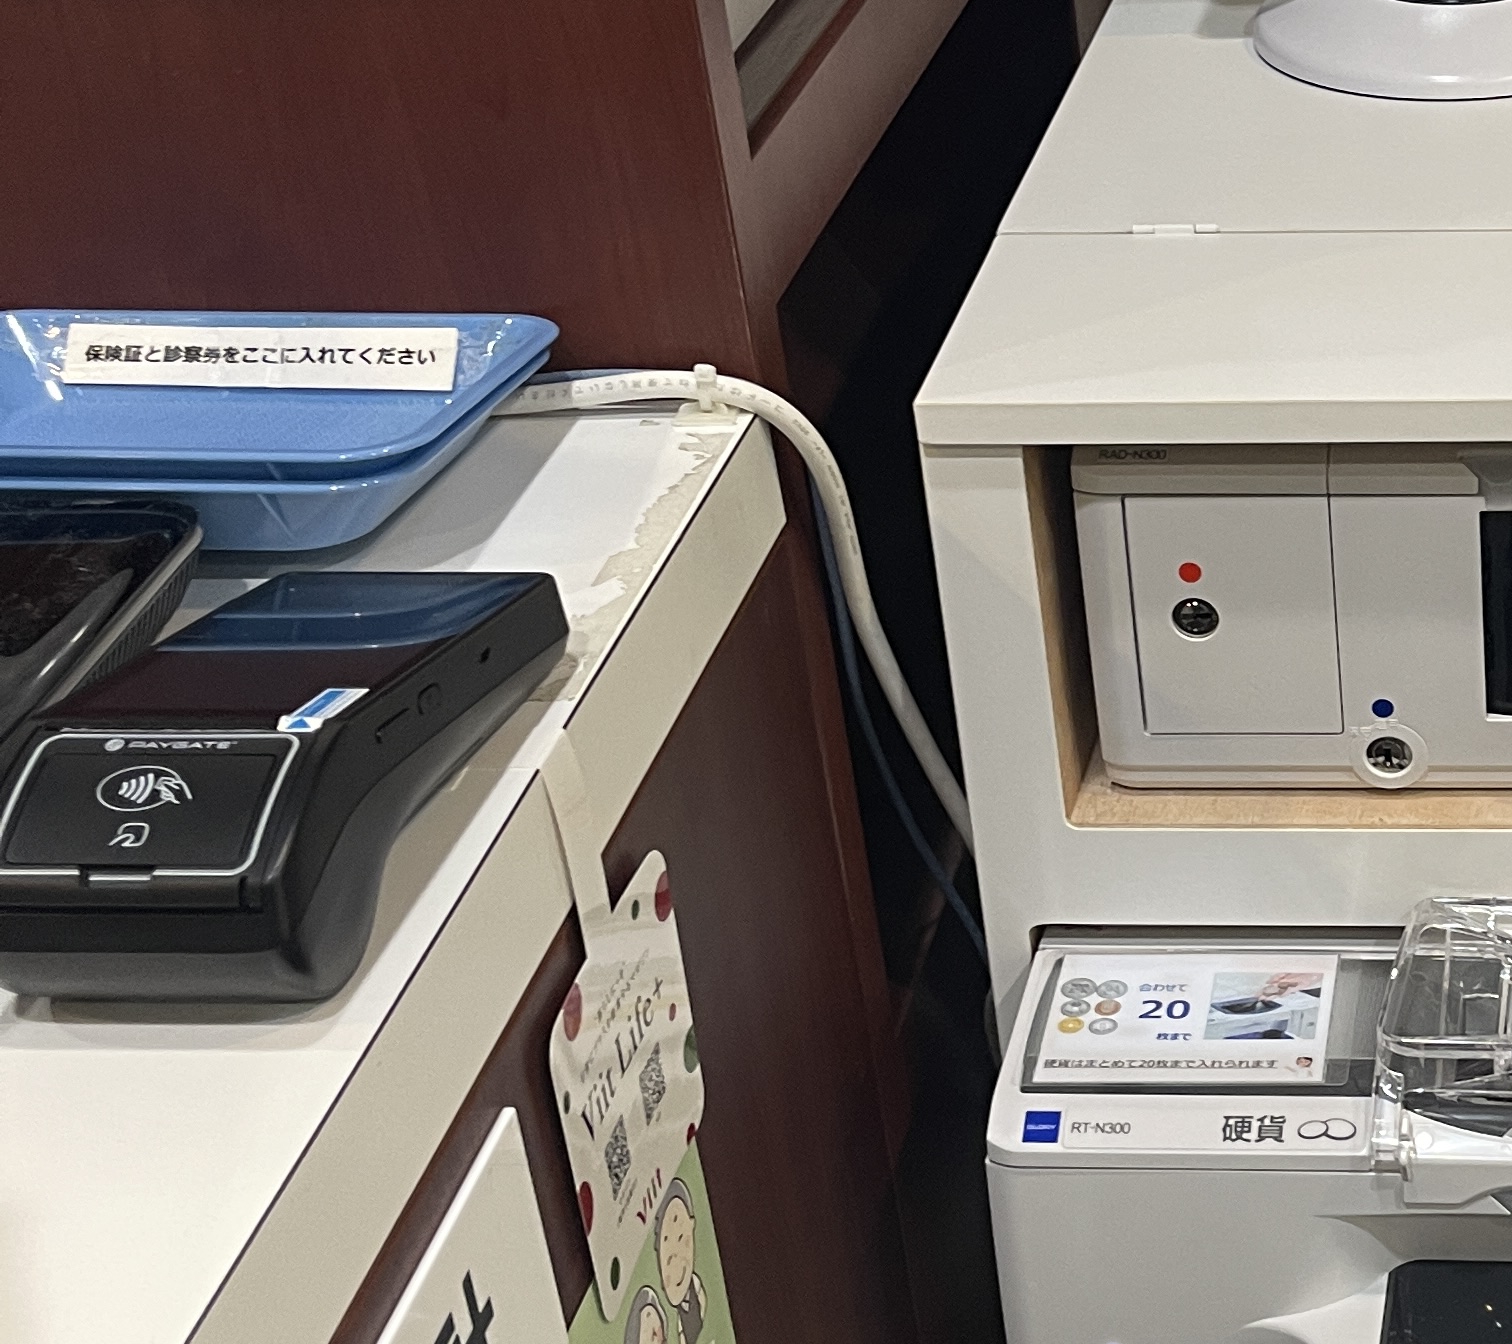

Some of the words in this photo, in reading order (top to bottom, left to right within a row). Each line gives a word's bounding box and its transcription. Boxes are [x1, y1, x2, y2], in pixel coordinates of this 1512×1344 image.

[85, 343, 437, 367] 保険証と診察券をここに入れてください
[1139, 983, 1187, 992] 合わせて
[1138, 1000, 1191, 1019] 20
[1070, 1121, 1132, 1135] RT-N300
[1222, 1115, 1287, 1143] 硬貨
